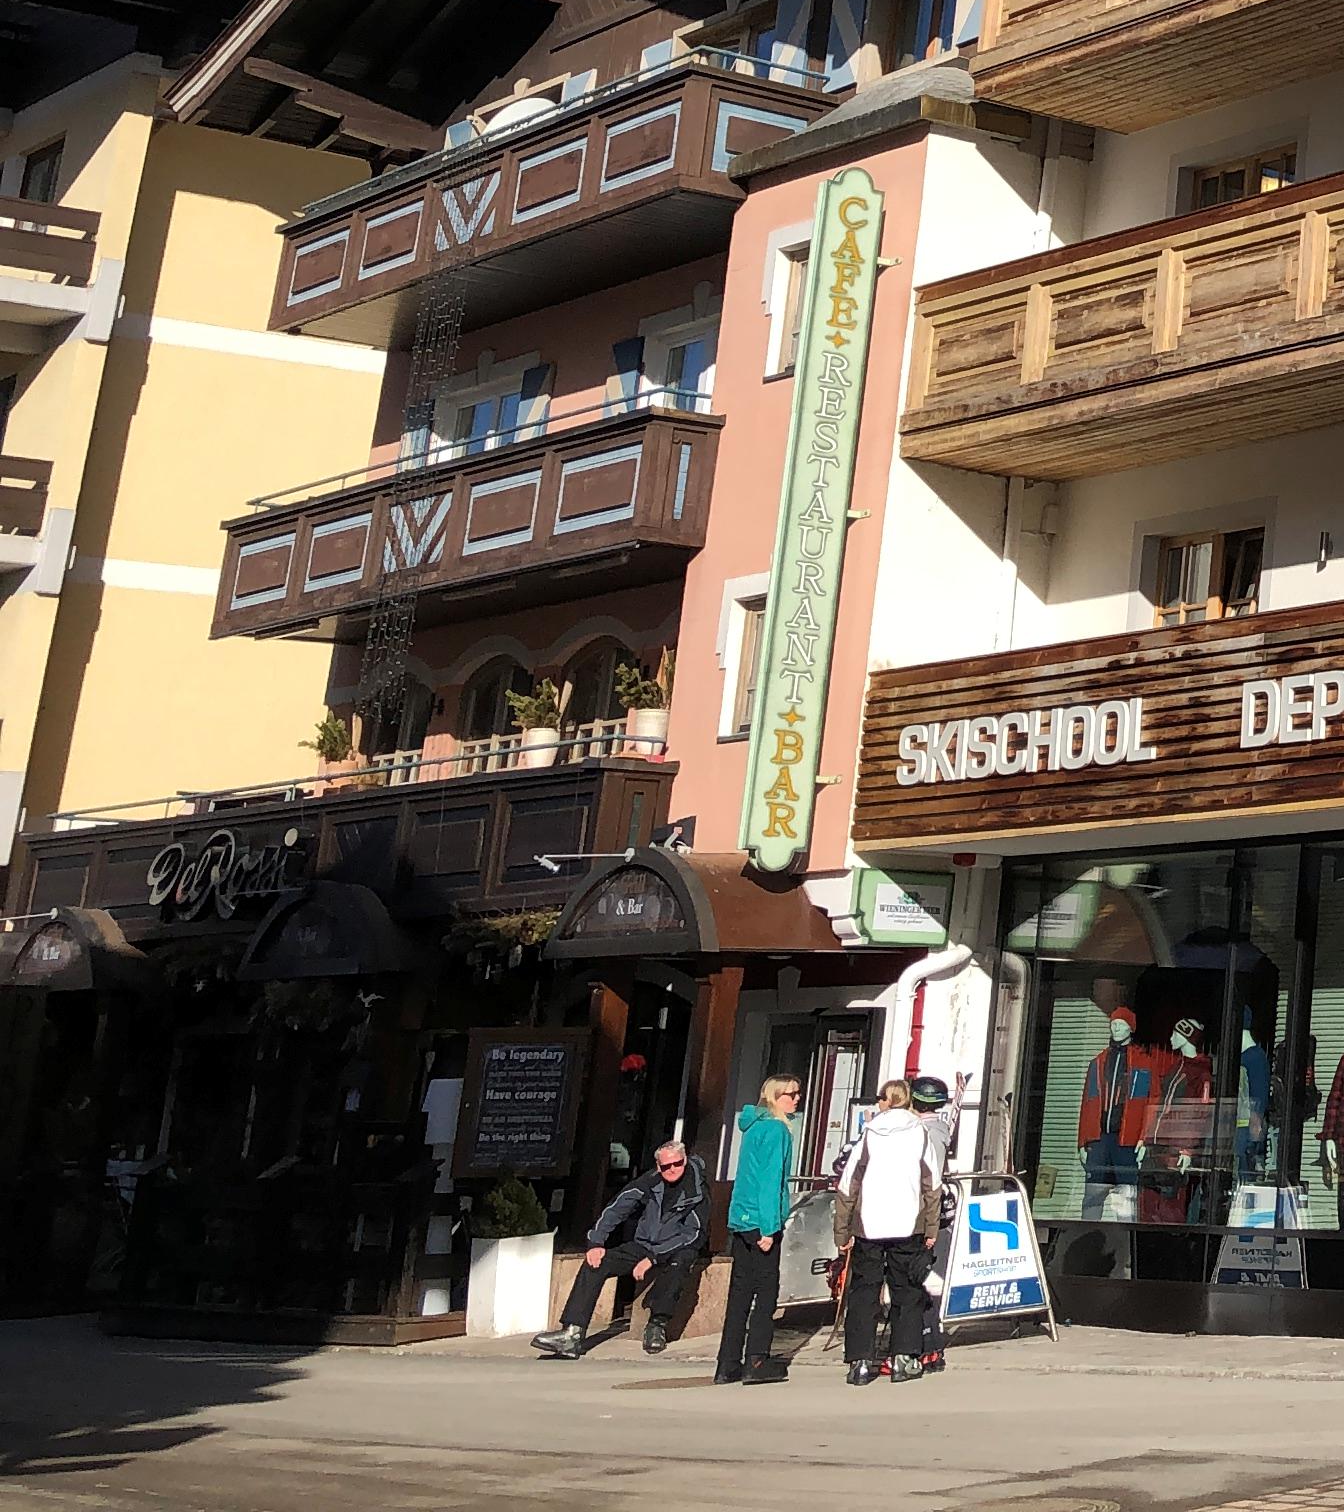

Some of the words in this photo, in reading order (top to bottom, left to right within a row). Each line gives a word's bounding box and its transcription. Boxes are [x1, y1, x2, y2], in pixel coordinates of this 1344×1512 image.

[826, 197, 868, 330] CAFE
[779, 352, 851, 704] RESTAURANT
[896, 697, 1157, 785] SKISCHOOL
[763, 728, 803, 838] BAR
[616, 899, 625, 916] &
[627, 898, 643, 915] Bar
[509, 1049, 564, 1062] legendary
[515, 1091, 556, 1101] courage
[962, 1256, 1027, 1269] HAGLEITNER
[974, 1283, 1007, 1297] RENT
[1009, 1282, 1018, 1294] &
[970, 1292, 1021, 1310] SERVICE
